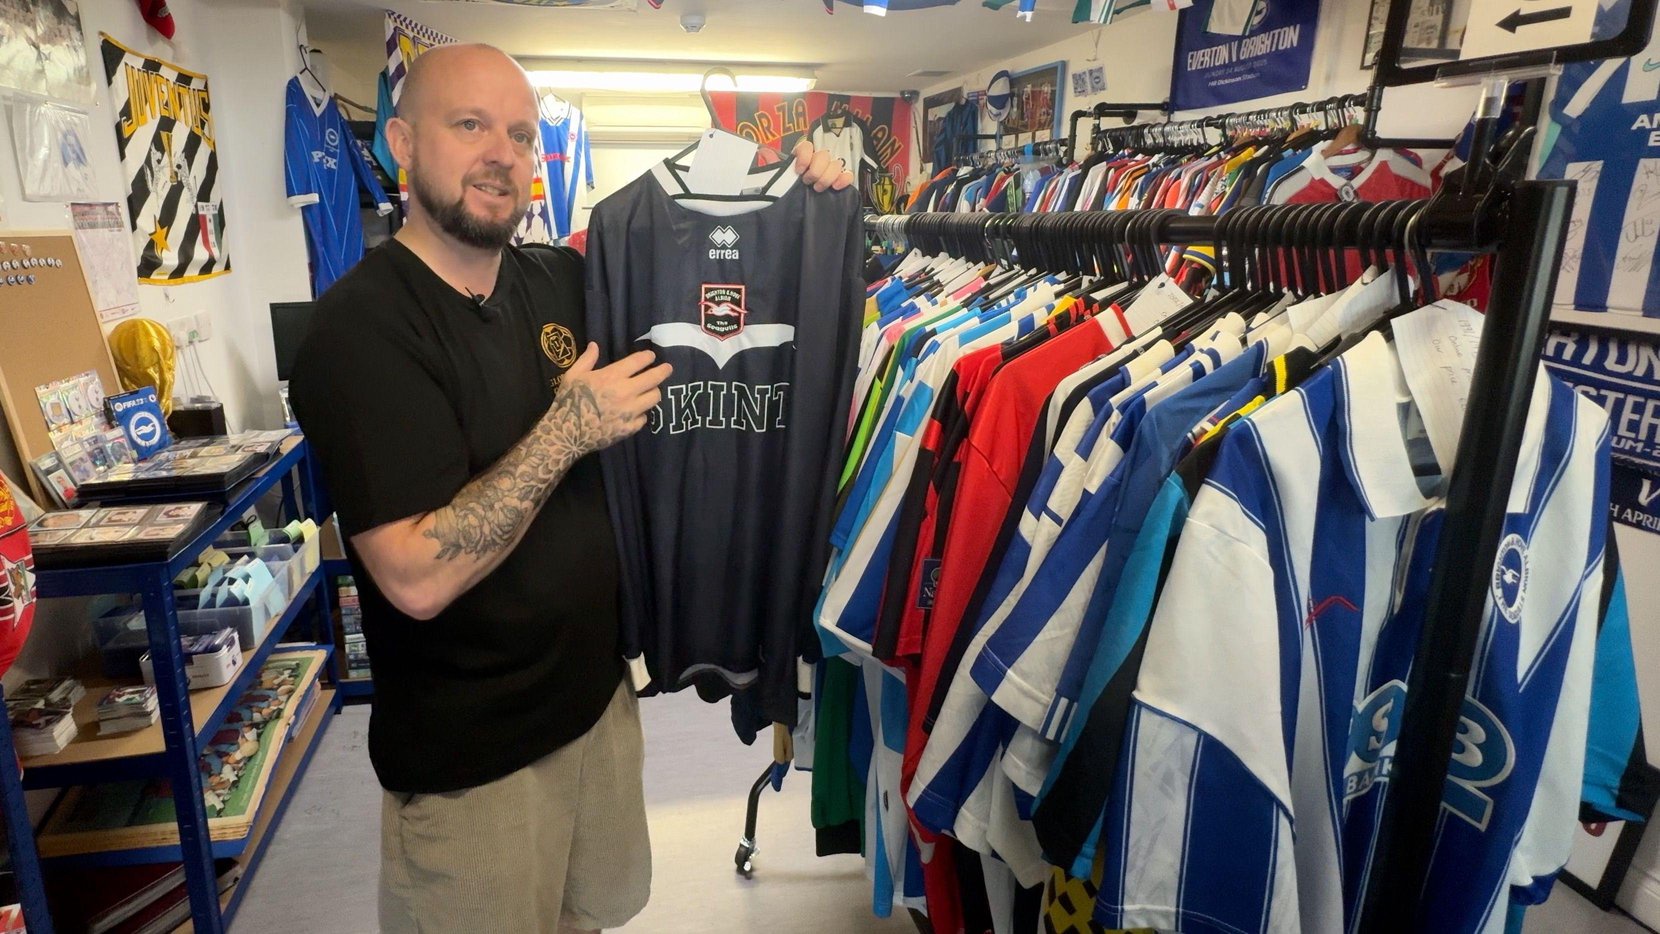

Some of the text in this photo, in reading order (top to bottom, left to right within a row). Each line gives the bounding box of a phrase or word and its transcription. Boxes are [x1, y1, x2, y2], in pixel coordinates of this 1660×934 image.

[1187, 24, 1300, 71] EVERTON V BRIGHTON
[122, 62, 215, 151] JUVENTUS
[737, 98, 809, 144] ORZA
[709, 248, 739, 259] errea
